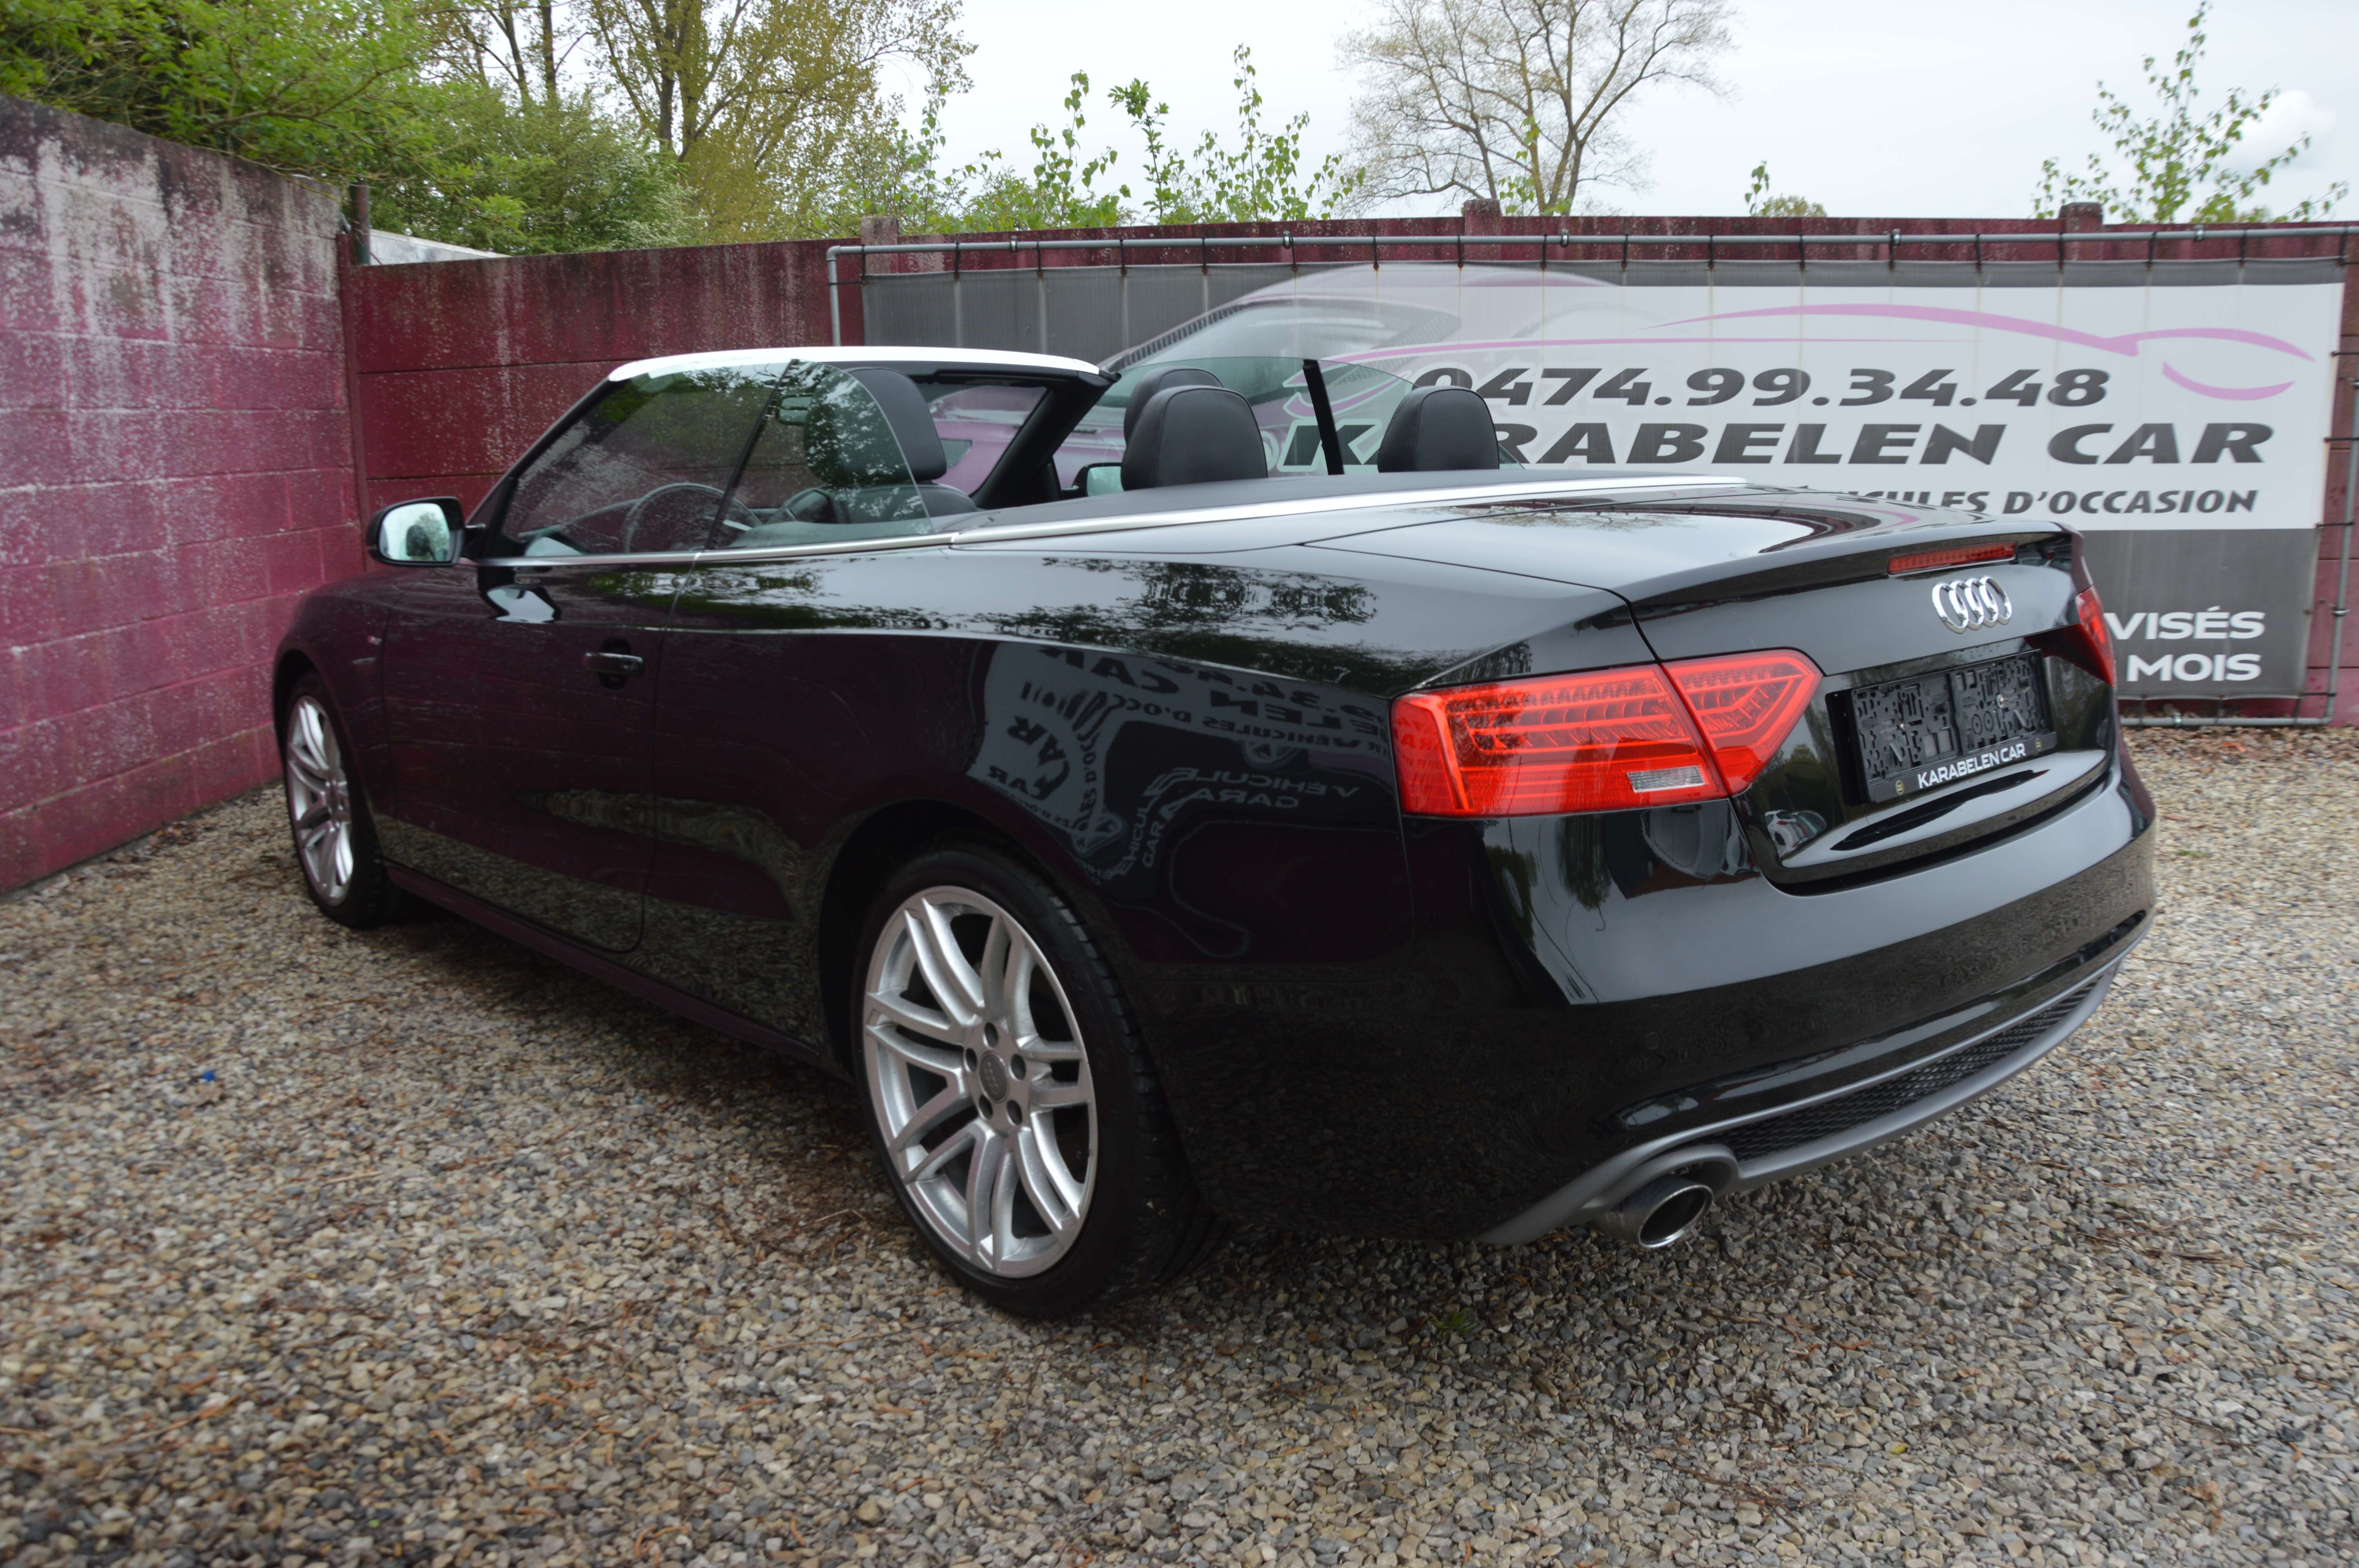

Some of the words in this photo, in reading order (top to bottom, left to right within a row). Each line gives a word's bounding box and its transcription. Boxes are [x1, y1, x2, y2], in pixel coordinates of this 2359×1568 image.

[1283, 423, 2007, 465] KRABELEN
[2048, 423, 2273, 465] CAR
[2003, 490, 2259, 514] D'OCCASION
[2126, 653, 2261, 681] MOIS
[1917, 751, 2000, 788] KARABELEN
[2000, 743, 2026, 762] CAR
